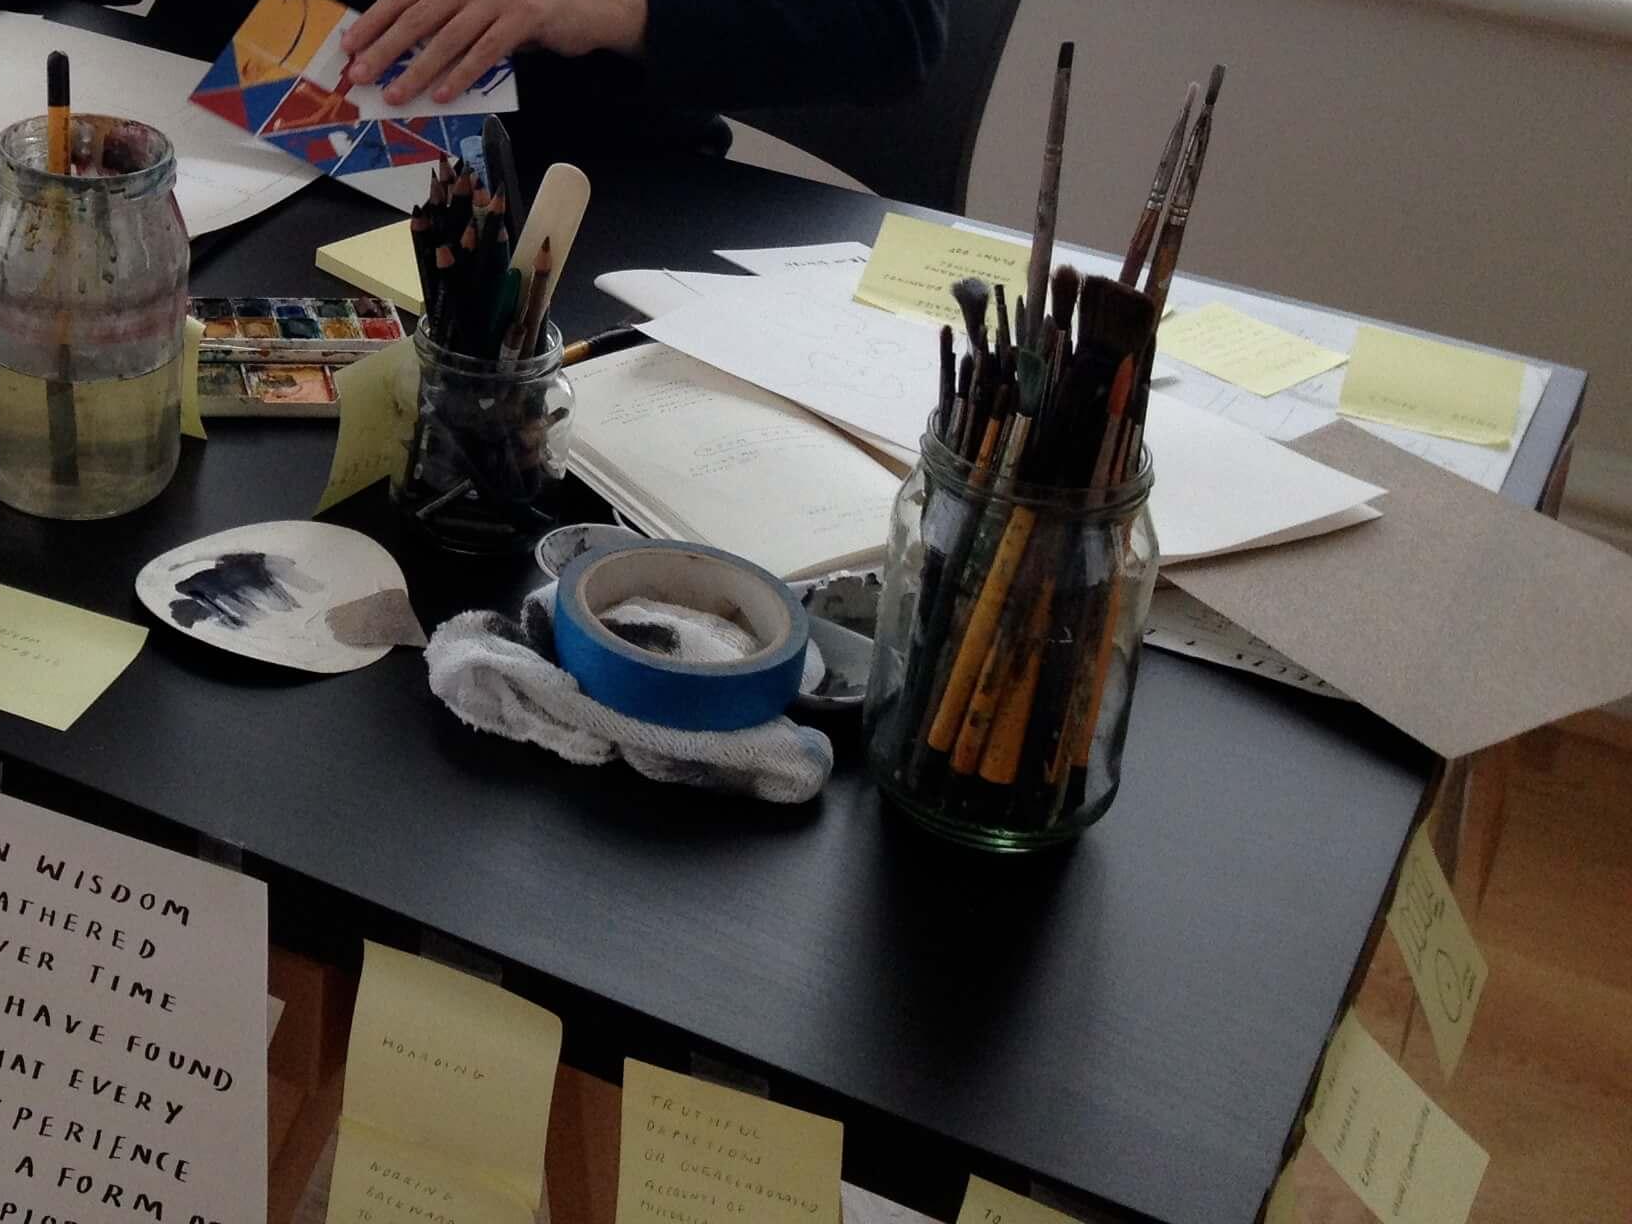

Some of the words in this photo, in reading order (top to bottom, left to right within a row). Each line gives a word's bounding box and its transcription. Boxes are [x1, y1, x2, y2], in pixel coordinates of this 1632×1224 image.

[36, 855, 190, 927] WISDOM
[89, 965, 178, 1013] TIME
[4, 995, 105, 1044] HAVE
[126, 1036, 234, 1093] FOUND
[69, 1069, 184, 1124] EVERY
[15, 1156, 35, 1178] A
[57, 1167, 164, 1221] FORM
